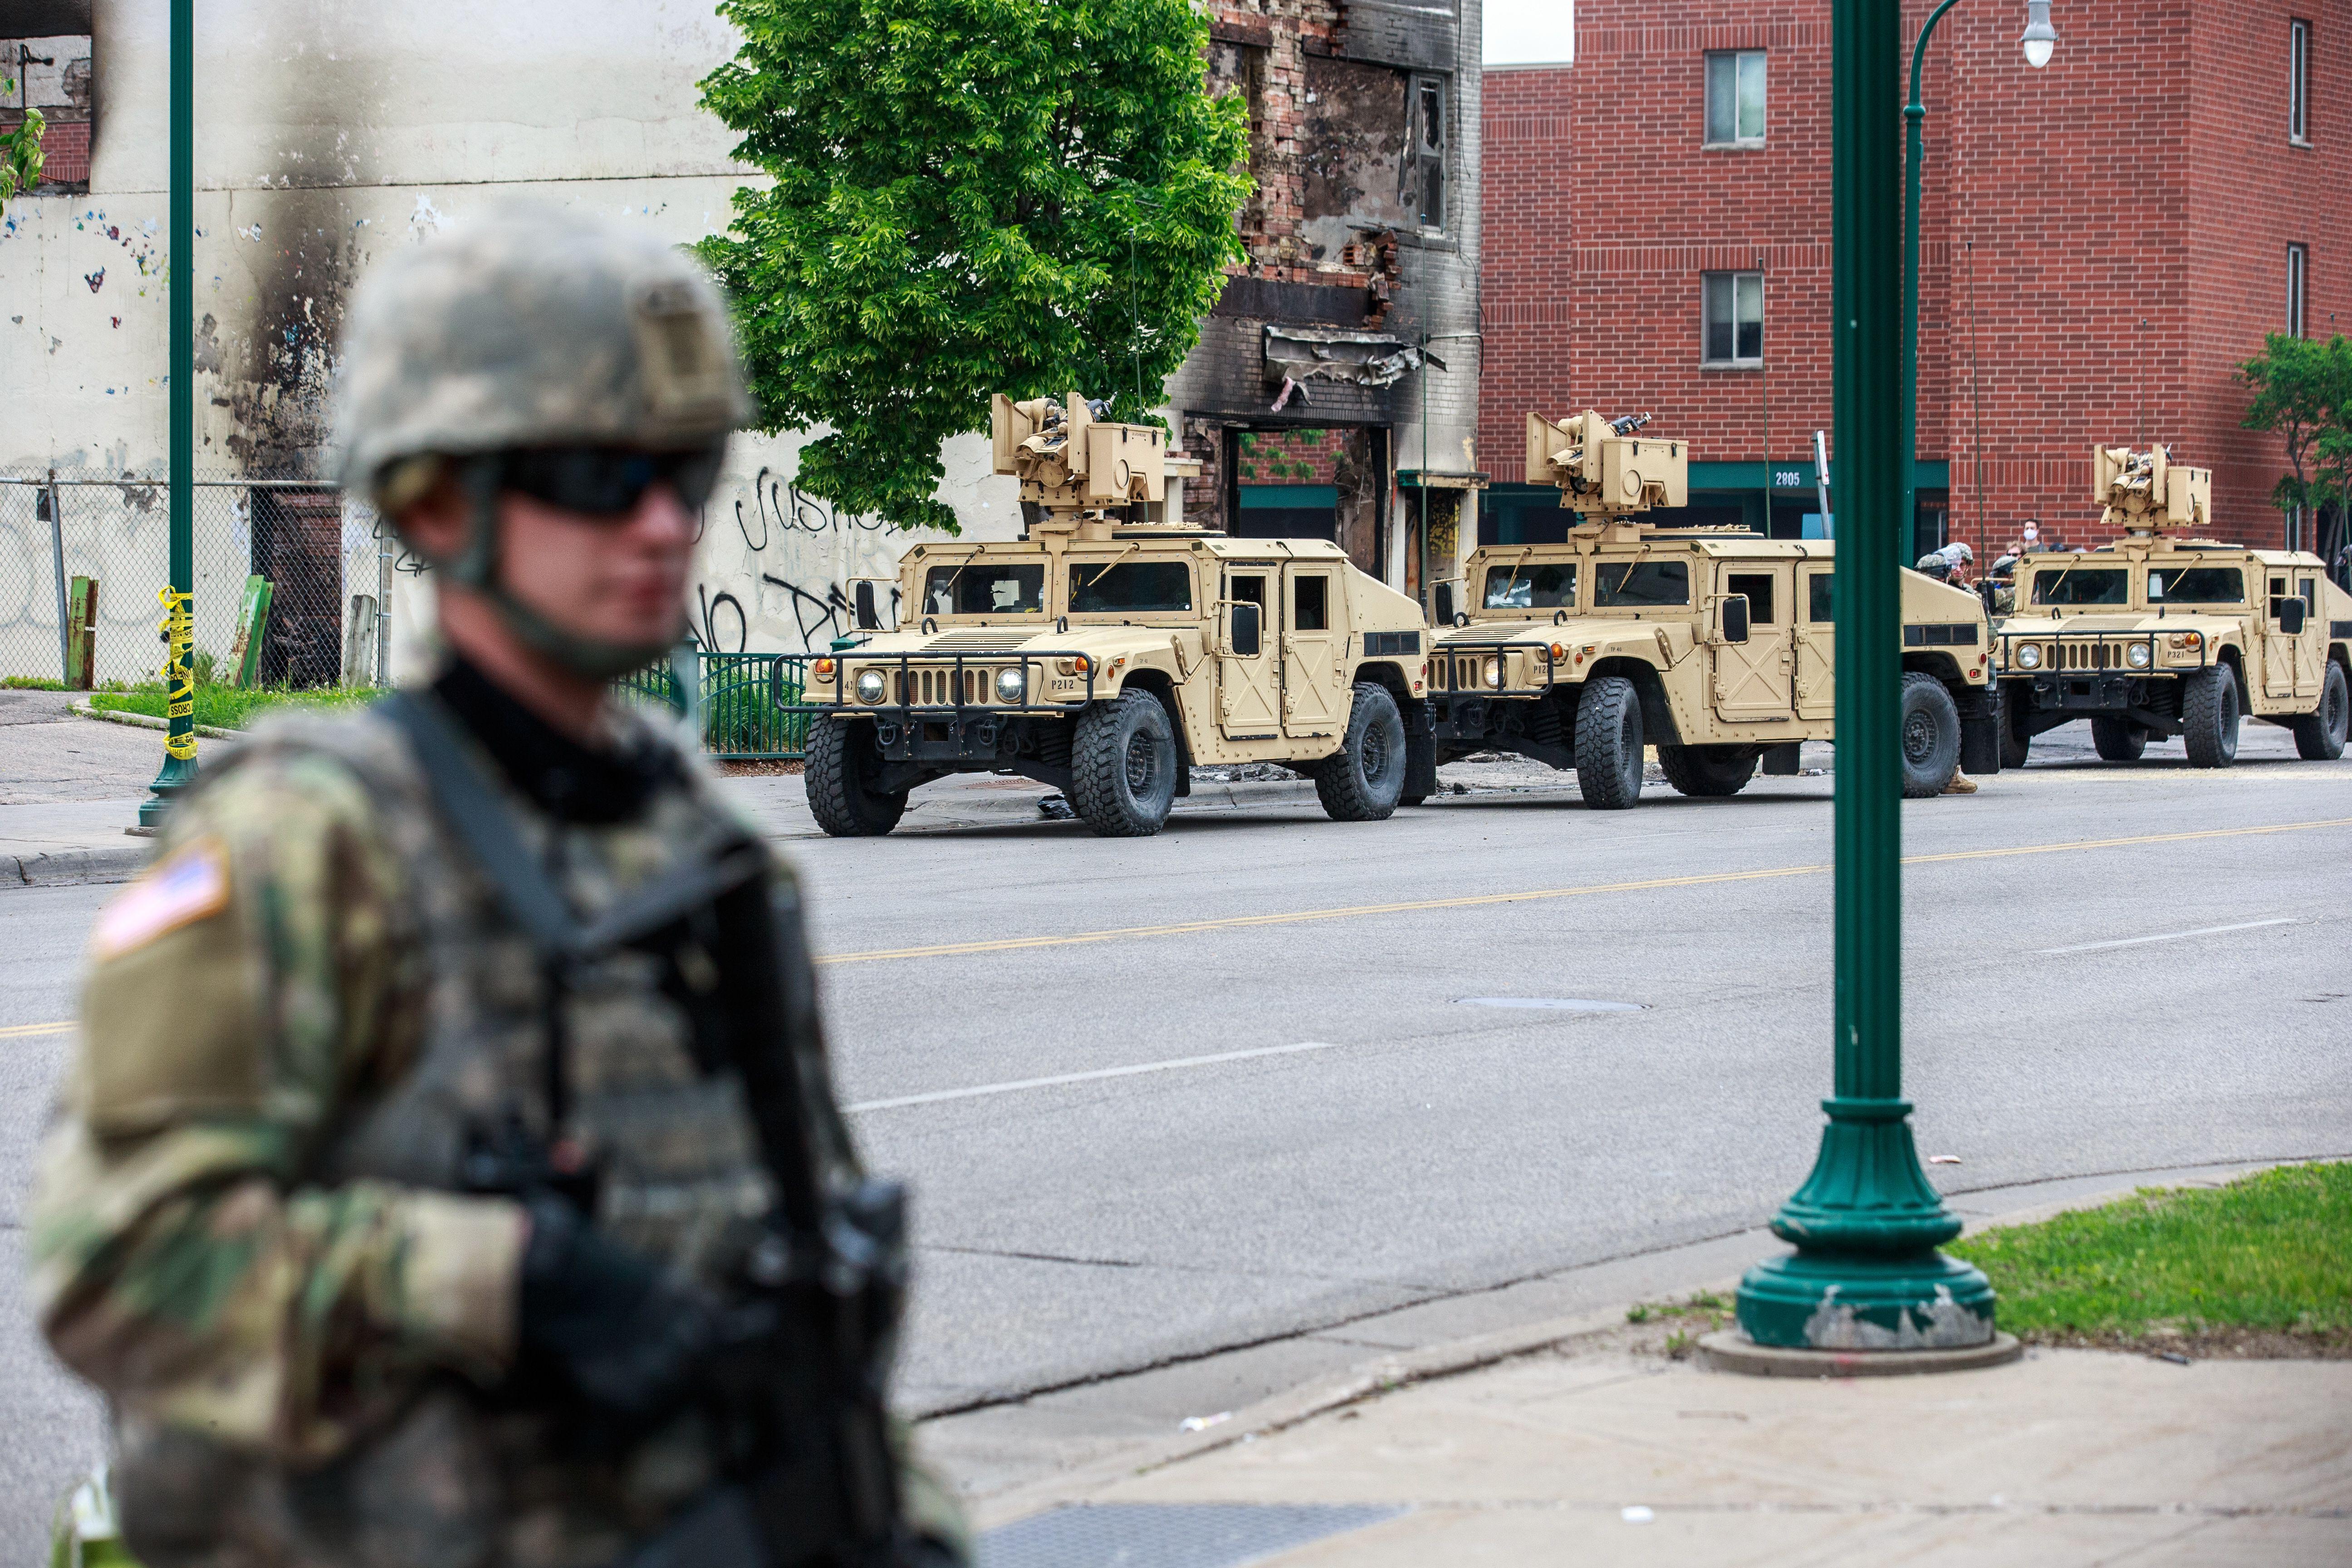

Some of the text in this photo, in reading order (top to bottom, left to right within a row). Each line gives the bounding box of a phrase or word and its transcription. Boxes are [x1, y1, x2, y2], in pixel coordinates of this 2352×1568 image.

[1776, 472, 1800, 486] 2805
[1534, 665, 1548, 674] P12
[1052, 679, 1074, 690] P212
[171, 703, 191, 715] CROSS
